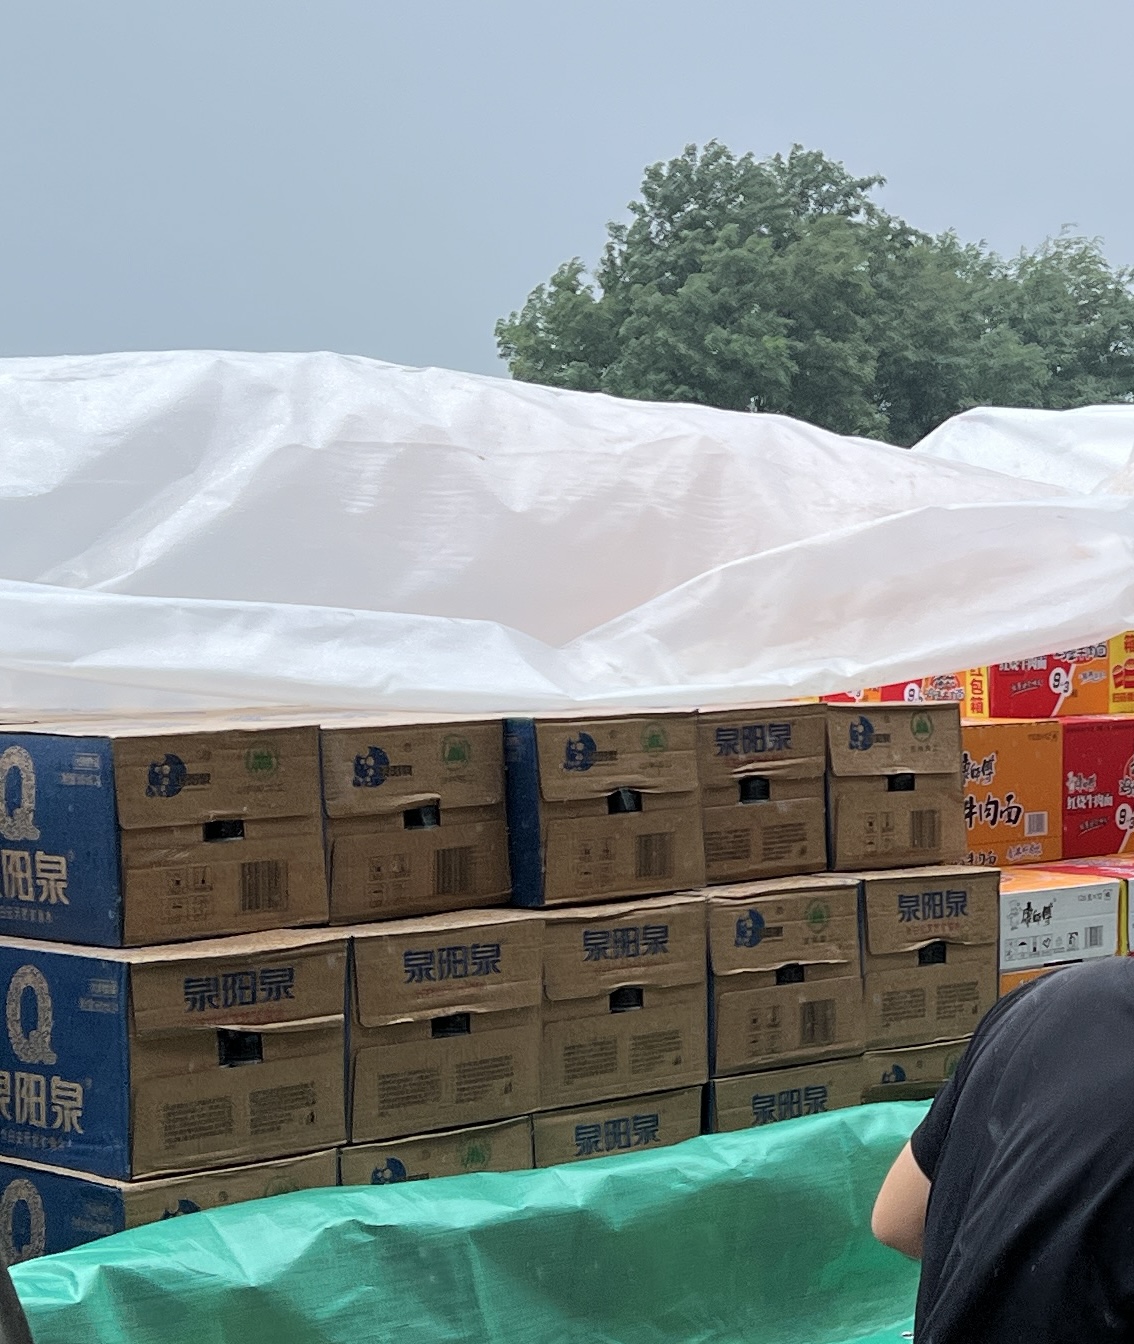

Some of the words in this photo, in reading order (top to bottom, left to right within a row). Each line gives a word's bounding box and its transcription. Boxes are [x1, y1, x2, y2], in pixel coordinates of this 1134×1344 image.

[716, 723, 792, 756] 泉阳泉
[0, 849, 70, 905] 阳泉
[898, 889, 969, 922] 泉阳泉
[403, 942, 502, 985] 泉阳泉
[583, 923, 669, 962] 泉阳泉
[183, 966, 296, 1013] 泉阳泉
[752, 1084, 829, 1126] 泉阳泉
[574, 1112, 662, 1157] 泉阳泉
